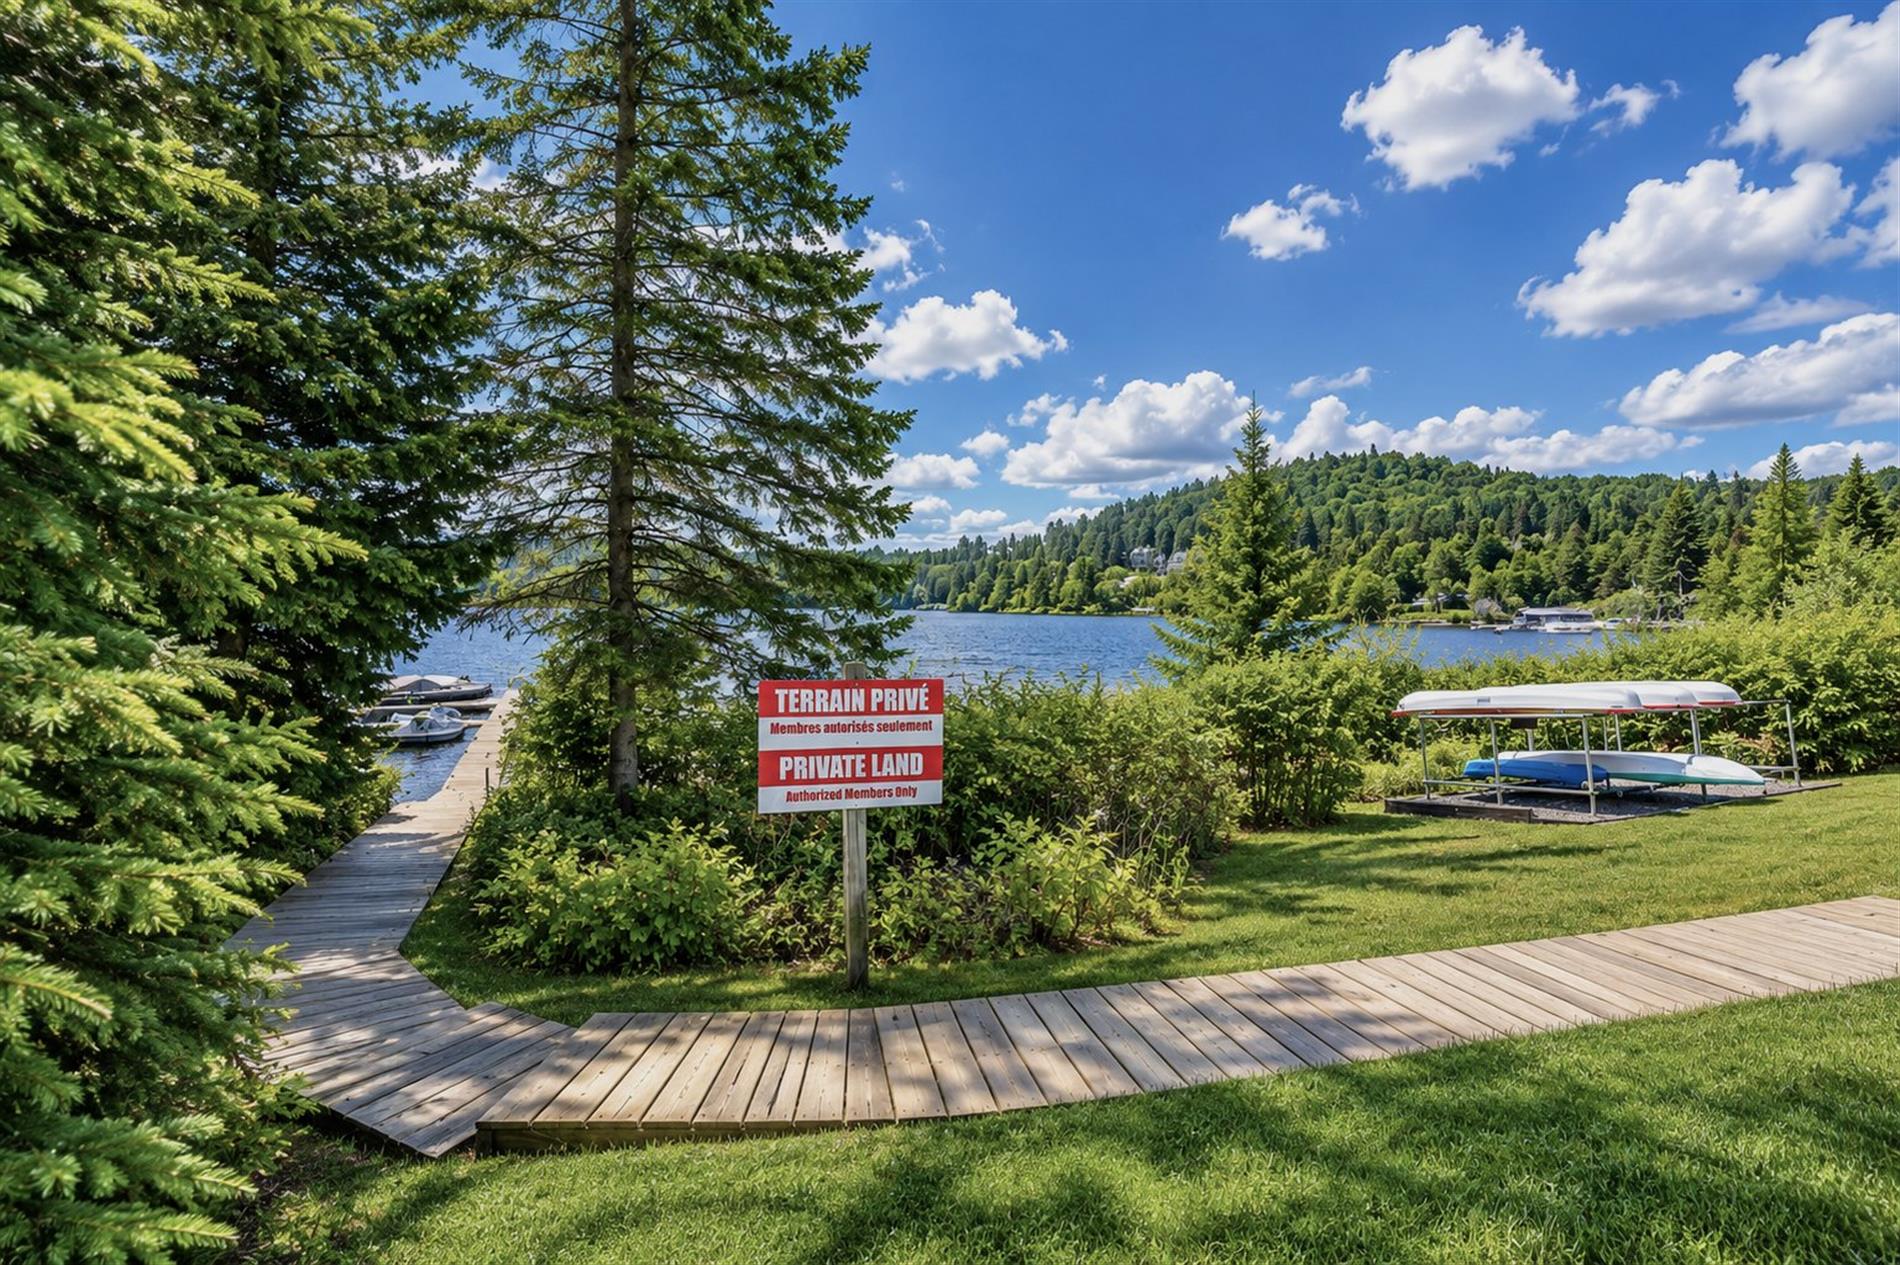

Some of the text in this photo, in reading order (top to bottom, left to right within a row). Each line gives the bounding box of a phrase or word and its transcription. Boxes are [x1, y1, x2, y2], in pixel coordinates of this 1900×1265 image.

[775, 683, 929, 713] TERRAIN PRIVÉ
[770, 720, 933, 734] Membres autorisés seulement
[779, 752, 924, 780] PRIVATE LAND
[785, 786, 917, 802] Authorized Members Only
